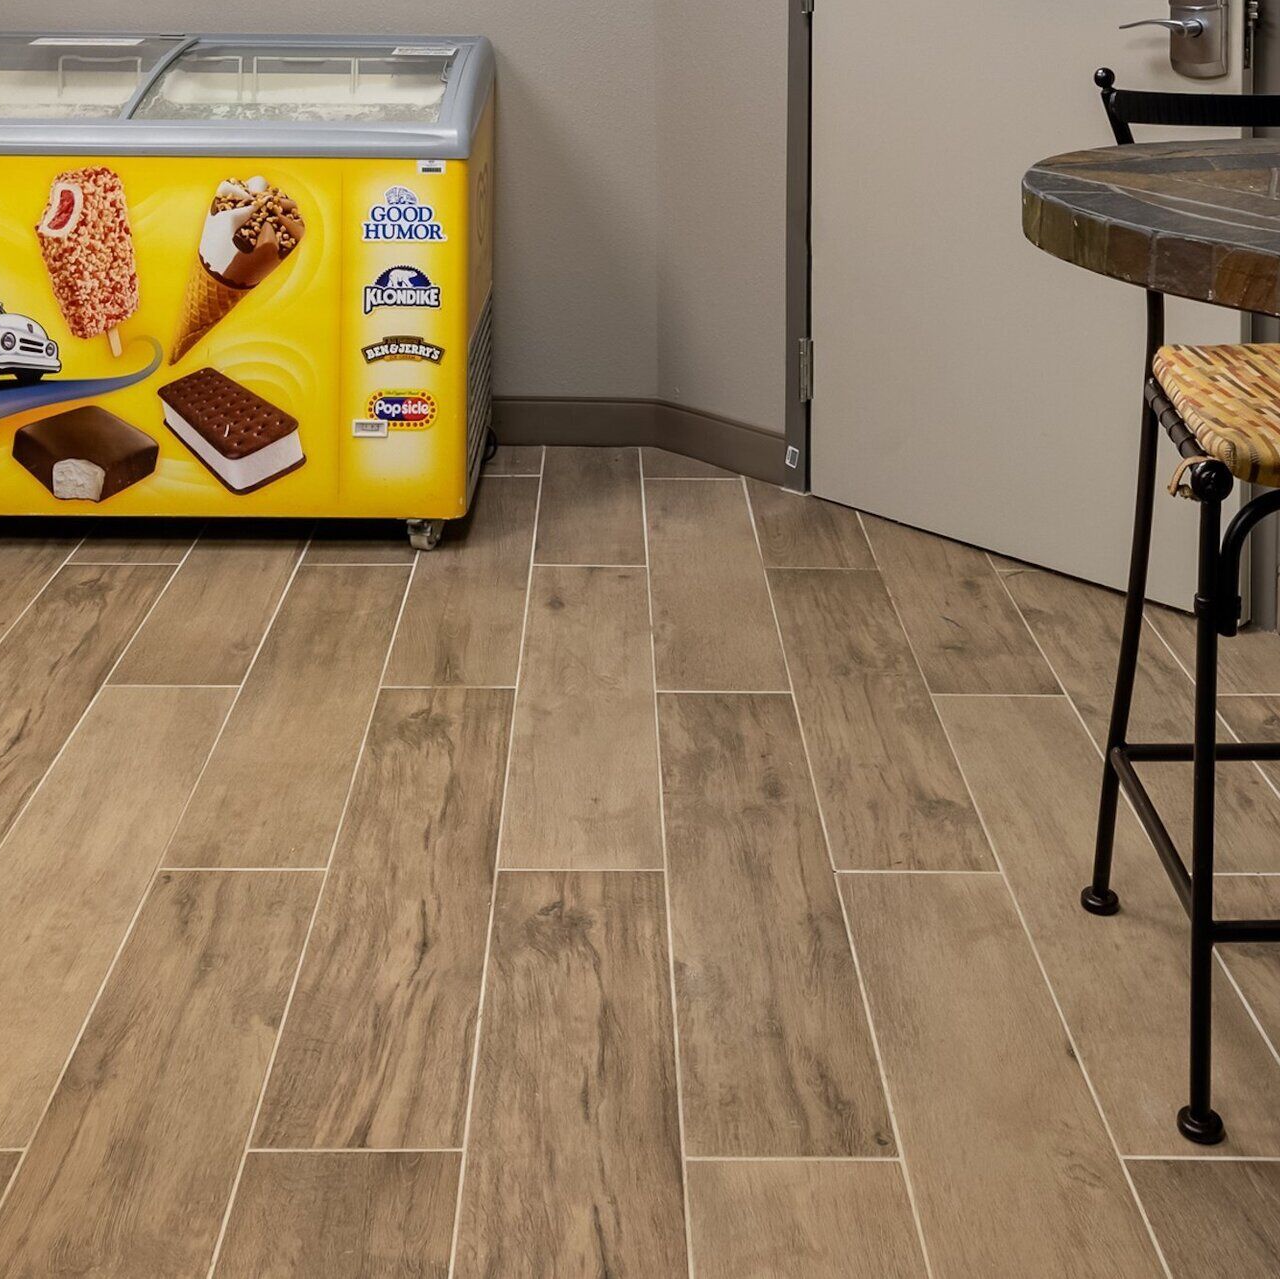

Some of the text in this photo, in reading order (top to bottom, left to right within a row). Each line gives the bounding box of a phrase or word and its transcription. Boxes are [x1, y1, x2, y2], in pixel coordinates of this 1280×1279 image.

[370, 206, 433, 223] GOOD
[364, 223, 444, 241] HUMOR
[366, 286, 440, 311] KLONDIKE
[375, 400, 430, 418] Popsicle
